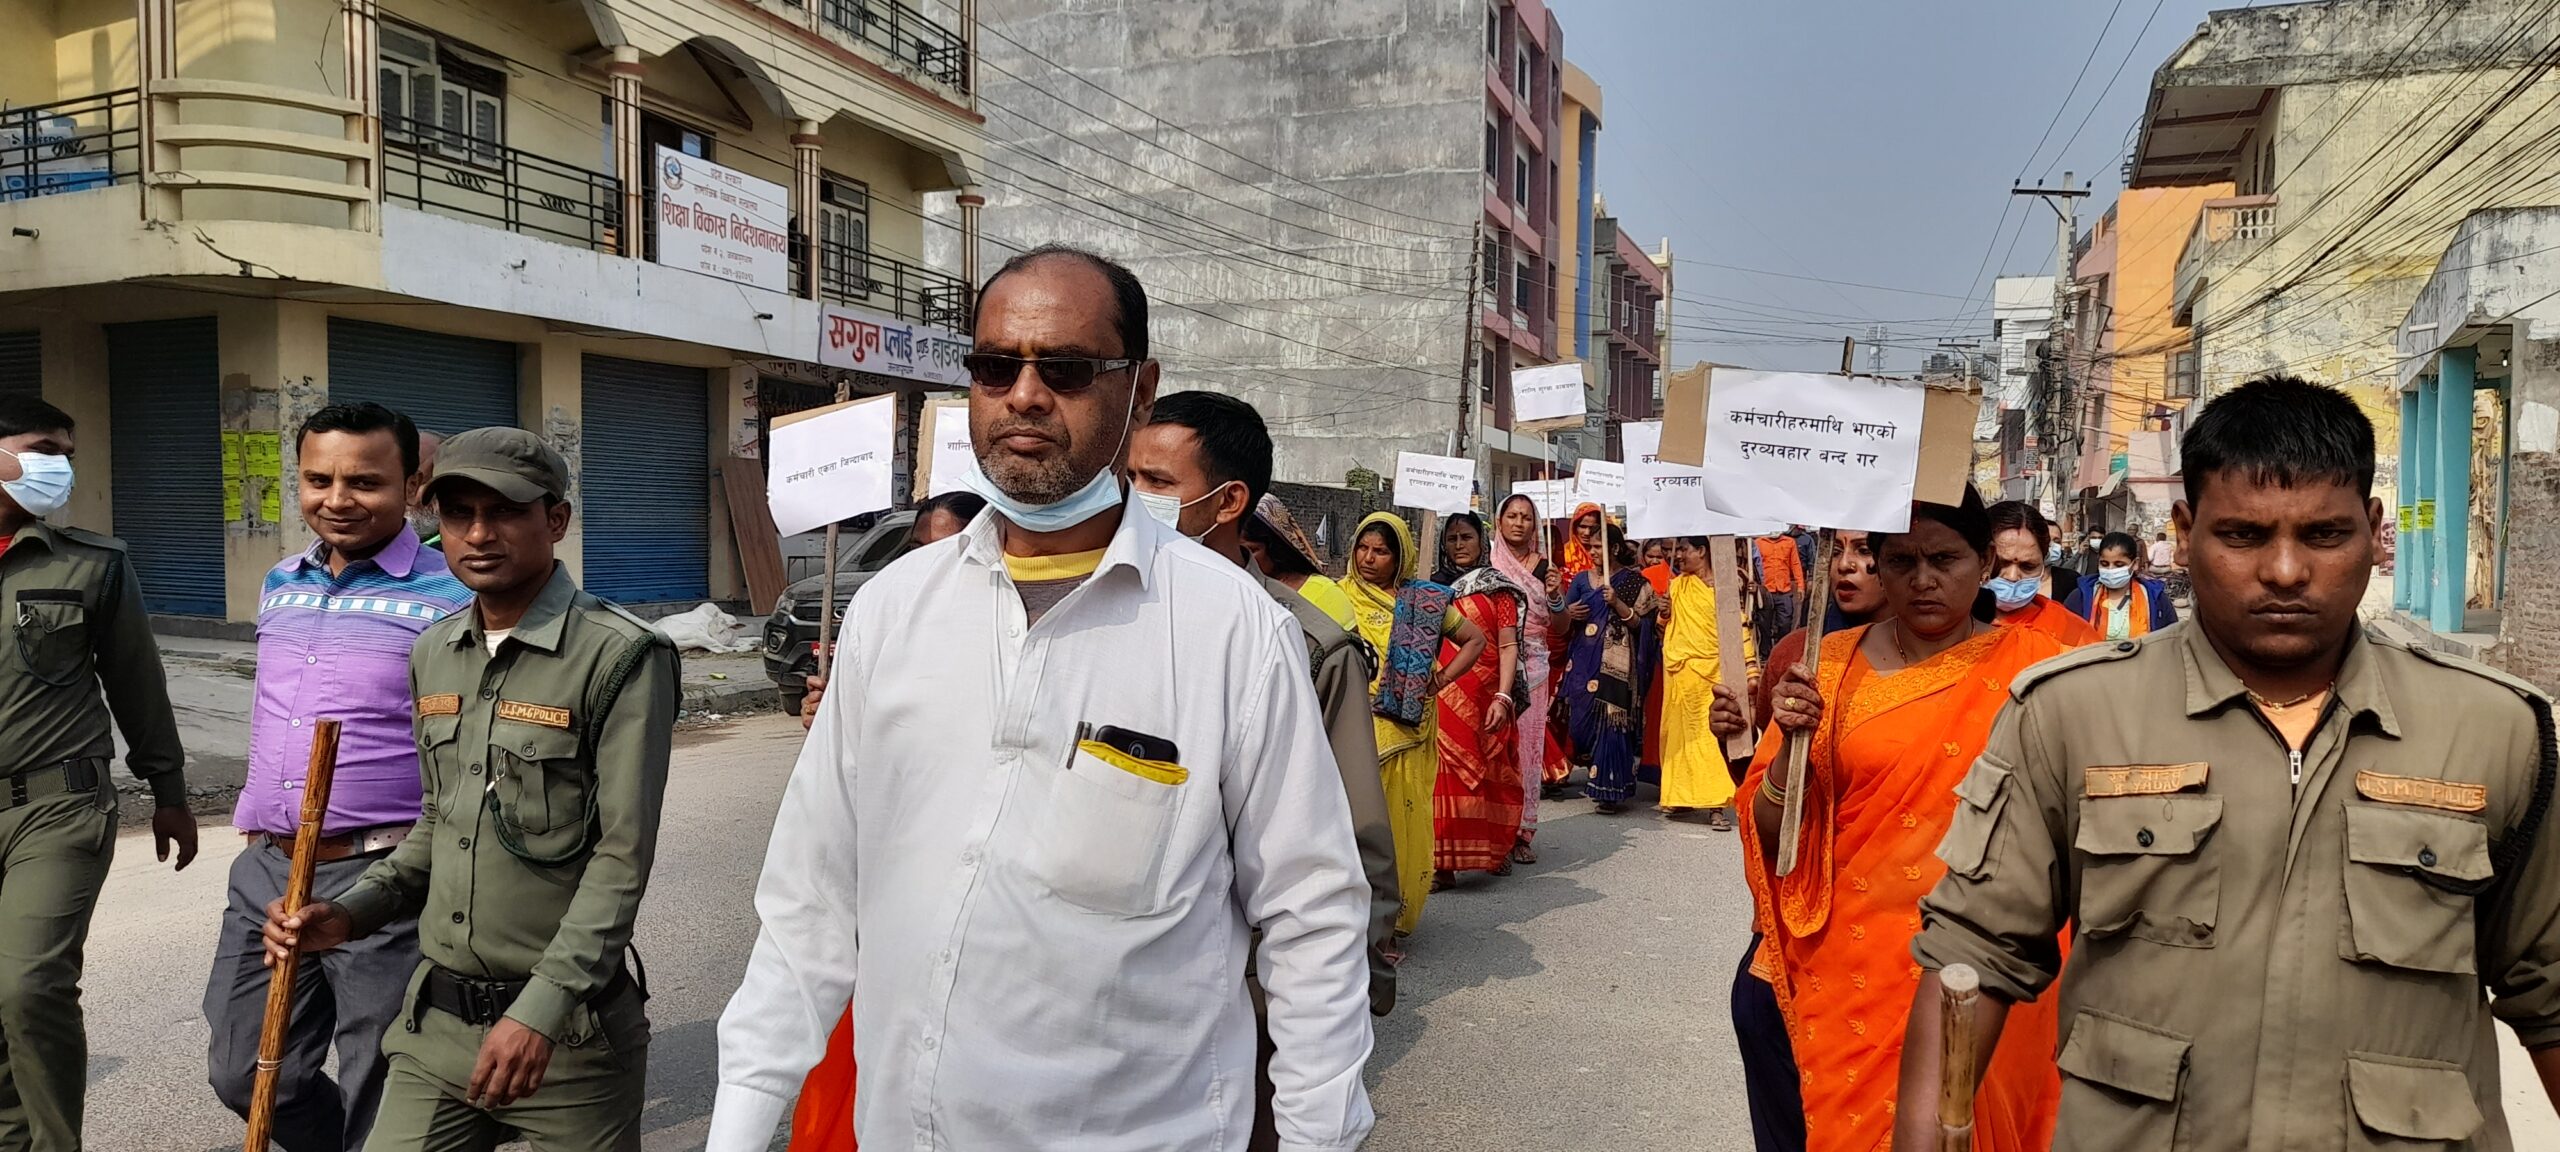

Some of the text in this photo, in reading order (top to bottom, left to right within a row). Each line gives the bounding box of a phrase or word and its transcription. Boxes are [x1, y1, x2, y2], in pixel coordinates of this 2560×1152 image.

[662, 193, 786, 255] शिक्षा विकास निर्देशनालय
[828, 314, 880, 362] सगुन
[883, 325, 913, 364] प्लाई
[1730, 407, 1898, 441] कर्मचारीहरुमाथि भएको
[1740, 440, 1812, 461] दुरव्यवहार
[1856, 453, 1879, 469] गर
[786, 466, 815, 484] कर्मचारी
[817, 462, 838, 476] एकता
[1653, 475, 1703, 491] दुरव्यवहा
[2134, 780, 2180, 792] YADAV
[2432, 784, 2484, 806] POLICE
